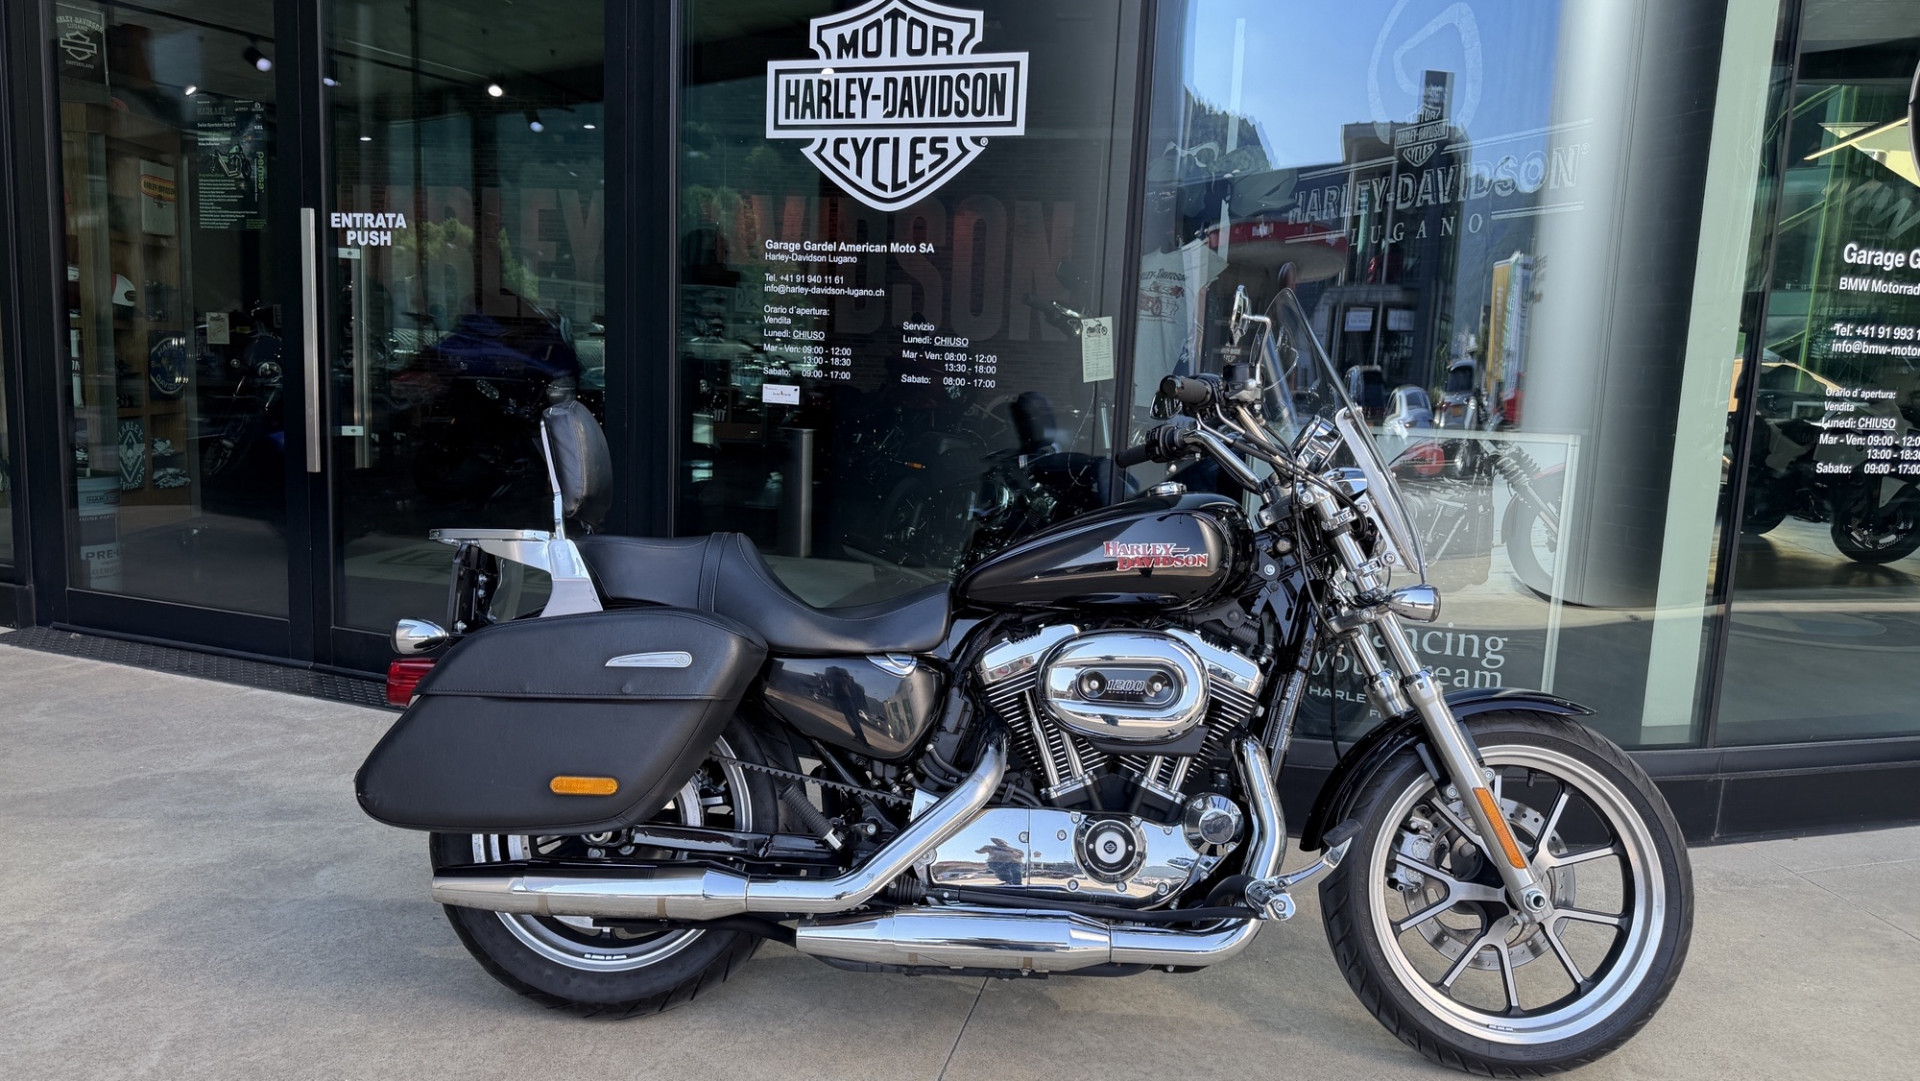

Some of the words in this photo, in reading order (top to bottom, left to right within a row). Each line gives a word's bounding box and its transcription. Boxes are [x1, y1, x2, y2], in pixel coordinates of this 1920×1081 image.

[836, 7, 954, 60] MOTOR
[784, 71, 1008, 120] HARLEY-DAVIDSON
[833, 136, 949, 194] CYCLES
[1288, 144, 1581, 226] HARLEY-DAVIDSON
[331, 212, 407, 229] ENTRATA
[1350, 213, 1483, 246] LUGANO
[346, 230, 392, 247] PUSH
[765, 239, 801, 252] Garage
[803, 241, 837, 252] Gardel
[838, 242, 887, 253] American
[890, 243, 917, 253] Moto
[919, 243, 935, 254] SA
[765, 252, 827, 263] Harley-Davidson
[828, 254, 857, 265] Lugano
[1843, 243, 1905, 271] Garage
[764, 273, 778, 283] Tel.
[779, 274, 794, 283] +41
[795, 275, 805, 283] 91
[807, 275, 822, 284] 940
[824, 275, 833, 284] 11
[834, 276, 844, 284] 61
[1839, 277, 1870, 292] BMW
[764, 284, 885, 297] info@harley-davidson-lugano.ch
[763, 305, 787, 314] Orario
[763, 315, 792, 325] Vendita
[902, 322, 935, 331] Servizio
[792, 330, 826, 341] CHIUSO
[1855, 325, 1875, 338] +41
[1877, 326, 1890, 339] 91
[1893, 327, 1914, 341] 993
[934, 336, 969, 347] CHIUSO
[763, 343, 778, 352] Mar
[784, 344, 801, 353] Ven:
[802, 346, 824, 355] 09:00
[830, 347, 852, 356] 12:00
[1832, 340, 1920, 357] info@bmw-motor
[802, 356, 824, 365] 13:00
[830, 358, 852, 367] 18:30
[902, 350, 918, 359] Mar
[924, 351, 943, 361] Ven:
[944, 352, 968, 362] 08:00
[974, 354, 998, 364] 12:00
[763, 367, 791, 377] Sabato:
[801, 370, 823, 378] 09:00
[830, 371, 851, 380] 17:00
[944, 363, 967, 373] 13:30
[974, 364, 997, 375] 18:00
[900, 373, 932, 384] Sabato:
[943, 376, 966, 386] 08:00
[973, 378, 996, 388] 17:00
[1825, 388, 1851, 397] Orario
[1824, 401, 1855, 412] Vendita
[1857, 418, 1896, 430] CHIUSO
[1819, 434, 1838, 444] Mar
[1846, 435, 1866, 445] Ven:
[1867, 436, 1893, 446] 09:00
[1867, 449, 1892, 460] 13:00
[1816, 463, 1852, 474] Sabato:
[1864, 464, 1889, 474] 09:00
[1117, 554, 1209, 571] DAVIDSON
[1106, 679, 1145, 691] 1200
